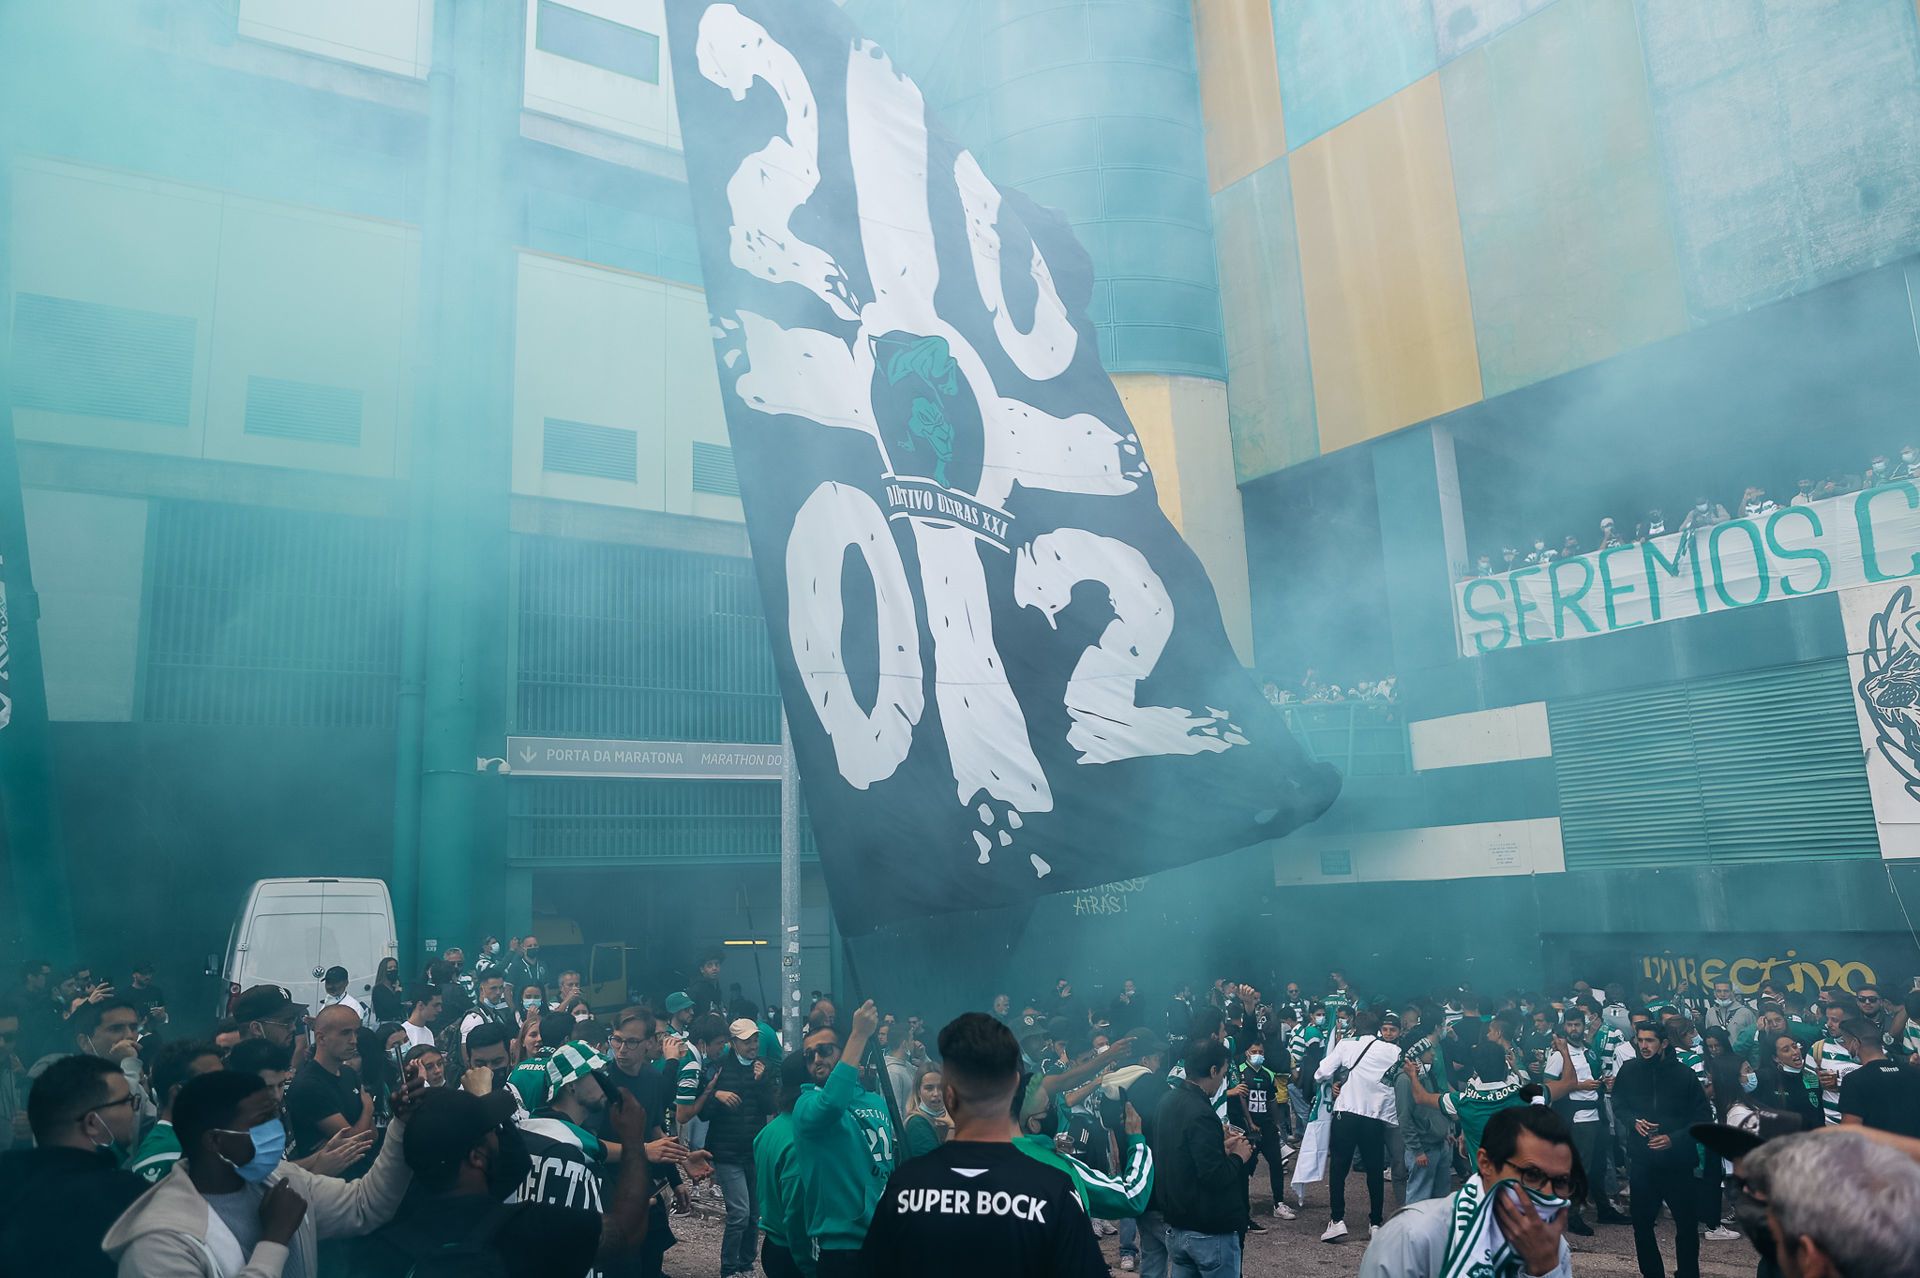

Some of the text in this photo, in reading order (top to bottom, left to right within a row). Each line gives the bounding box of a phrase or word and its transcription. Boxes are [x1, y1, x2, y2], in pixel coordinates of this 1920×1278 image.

[982, 511, 1009, 540] XXI
[1463, 506, 1832, 654] SEREMOS
[546, 749, 783, 766] PORTA DA MARATONA MARATHON DO
[897, 1188, 1047, 1224] SUPER BOCK
